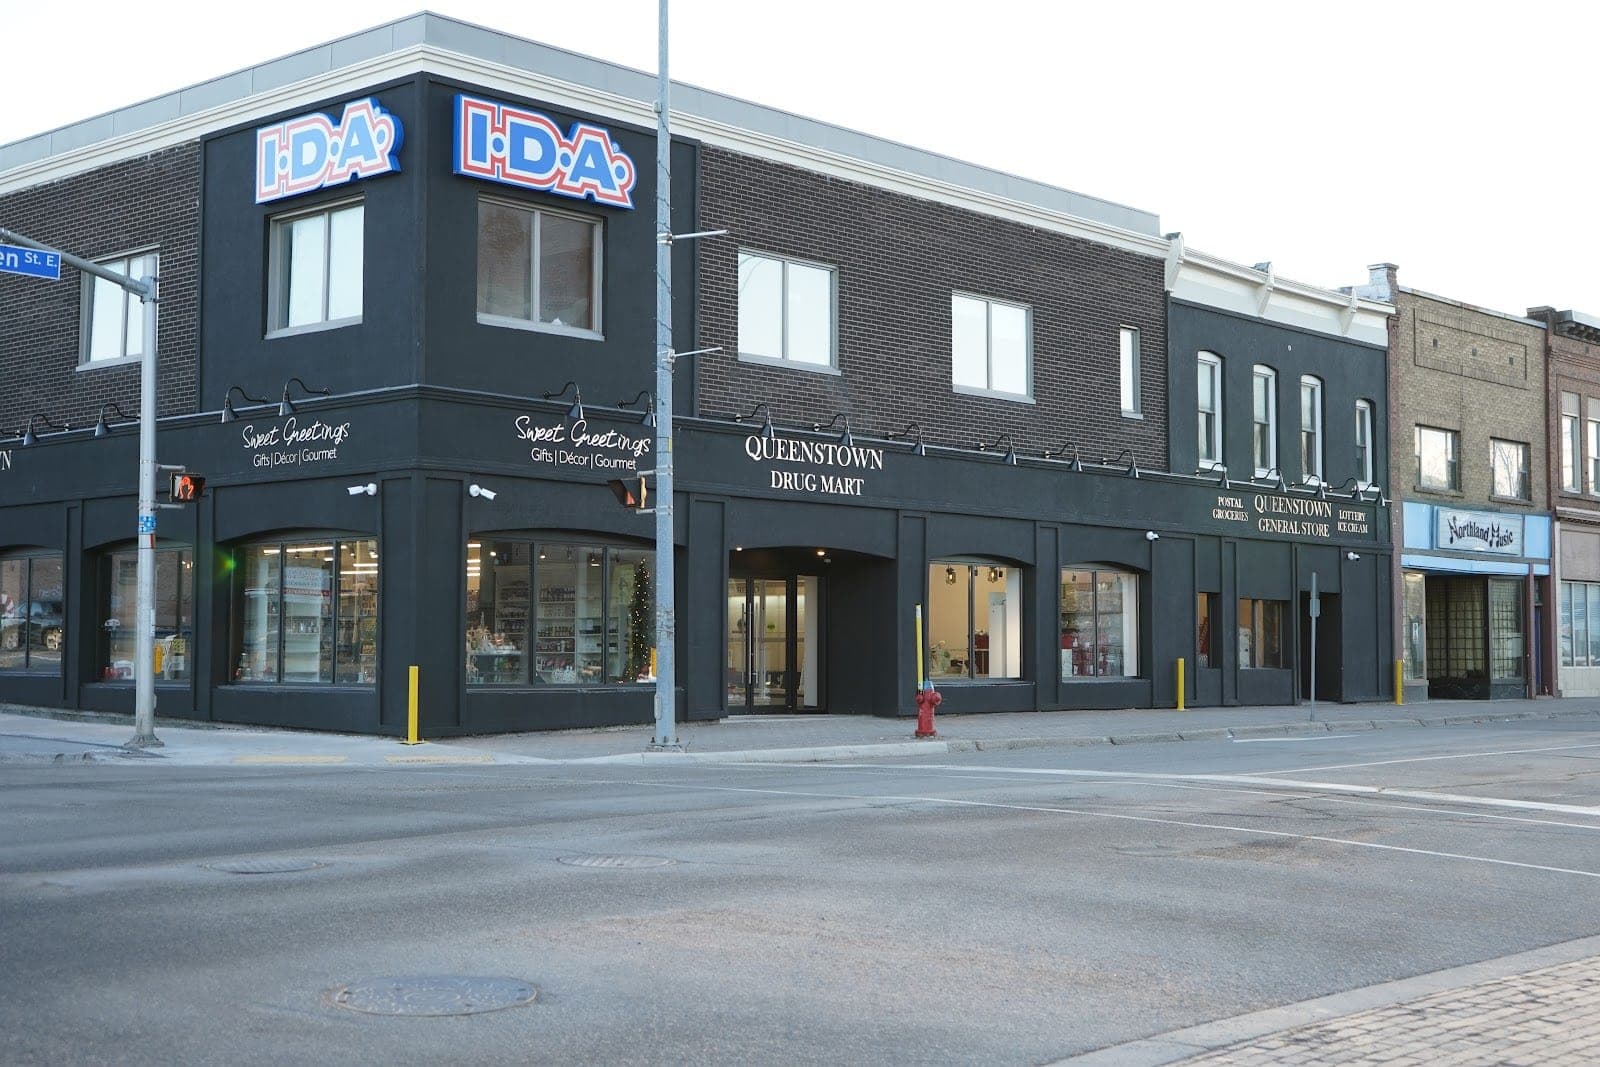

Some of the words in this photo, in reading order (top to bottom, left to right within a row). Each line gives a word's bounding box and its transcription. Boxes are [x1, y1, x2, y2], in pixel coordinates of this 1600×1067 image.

[24, 251, 42, 265] St.
[46, 255, 58, 268] E.
[242, 425, 279, 449] Sweet
[283, 417, 351, 446] Greetings
[515, 415, 565, 443] Sweet
[570, 420, 651, 457] Greetings
[0, 449, 12, 471] N
[253, 453, 270, 467] Gifts
[274, 452, 298, 465] Décor
[302, 448, 337, 462] Gourmet
[531, 447, 553, 463] Gifts
[559, 450, 589, 466] Décor
[595, 453, 637, 471] Gourmet
[745, 435, 883, 470] QUEENSTOWN
[770, 470, 817, 492] DRUG
[820, 475, 865, 496] MART
[1217, 496, 1244, 509] POSTAL
[1254, 494, 1332, 518] QUEENSTOWN
[1212, 508, 1249, 522] GROCERIES
[1339, 509, 1366, 522] LOTTERY
[1258, 518, 1301, 535] GENERAL
[1301, 522, 1330, 537] STORE
[1337, 521, 1348, 532] ICE
[1348, 522, 1369, 534] CREAM
[1447, 515, 1490, 544] Northland
[1489, 521, 1514, 548] Music
